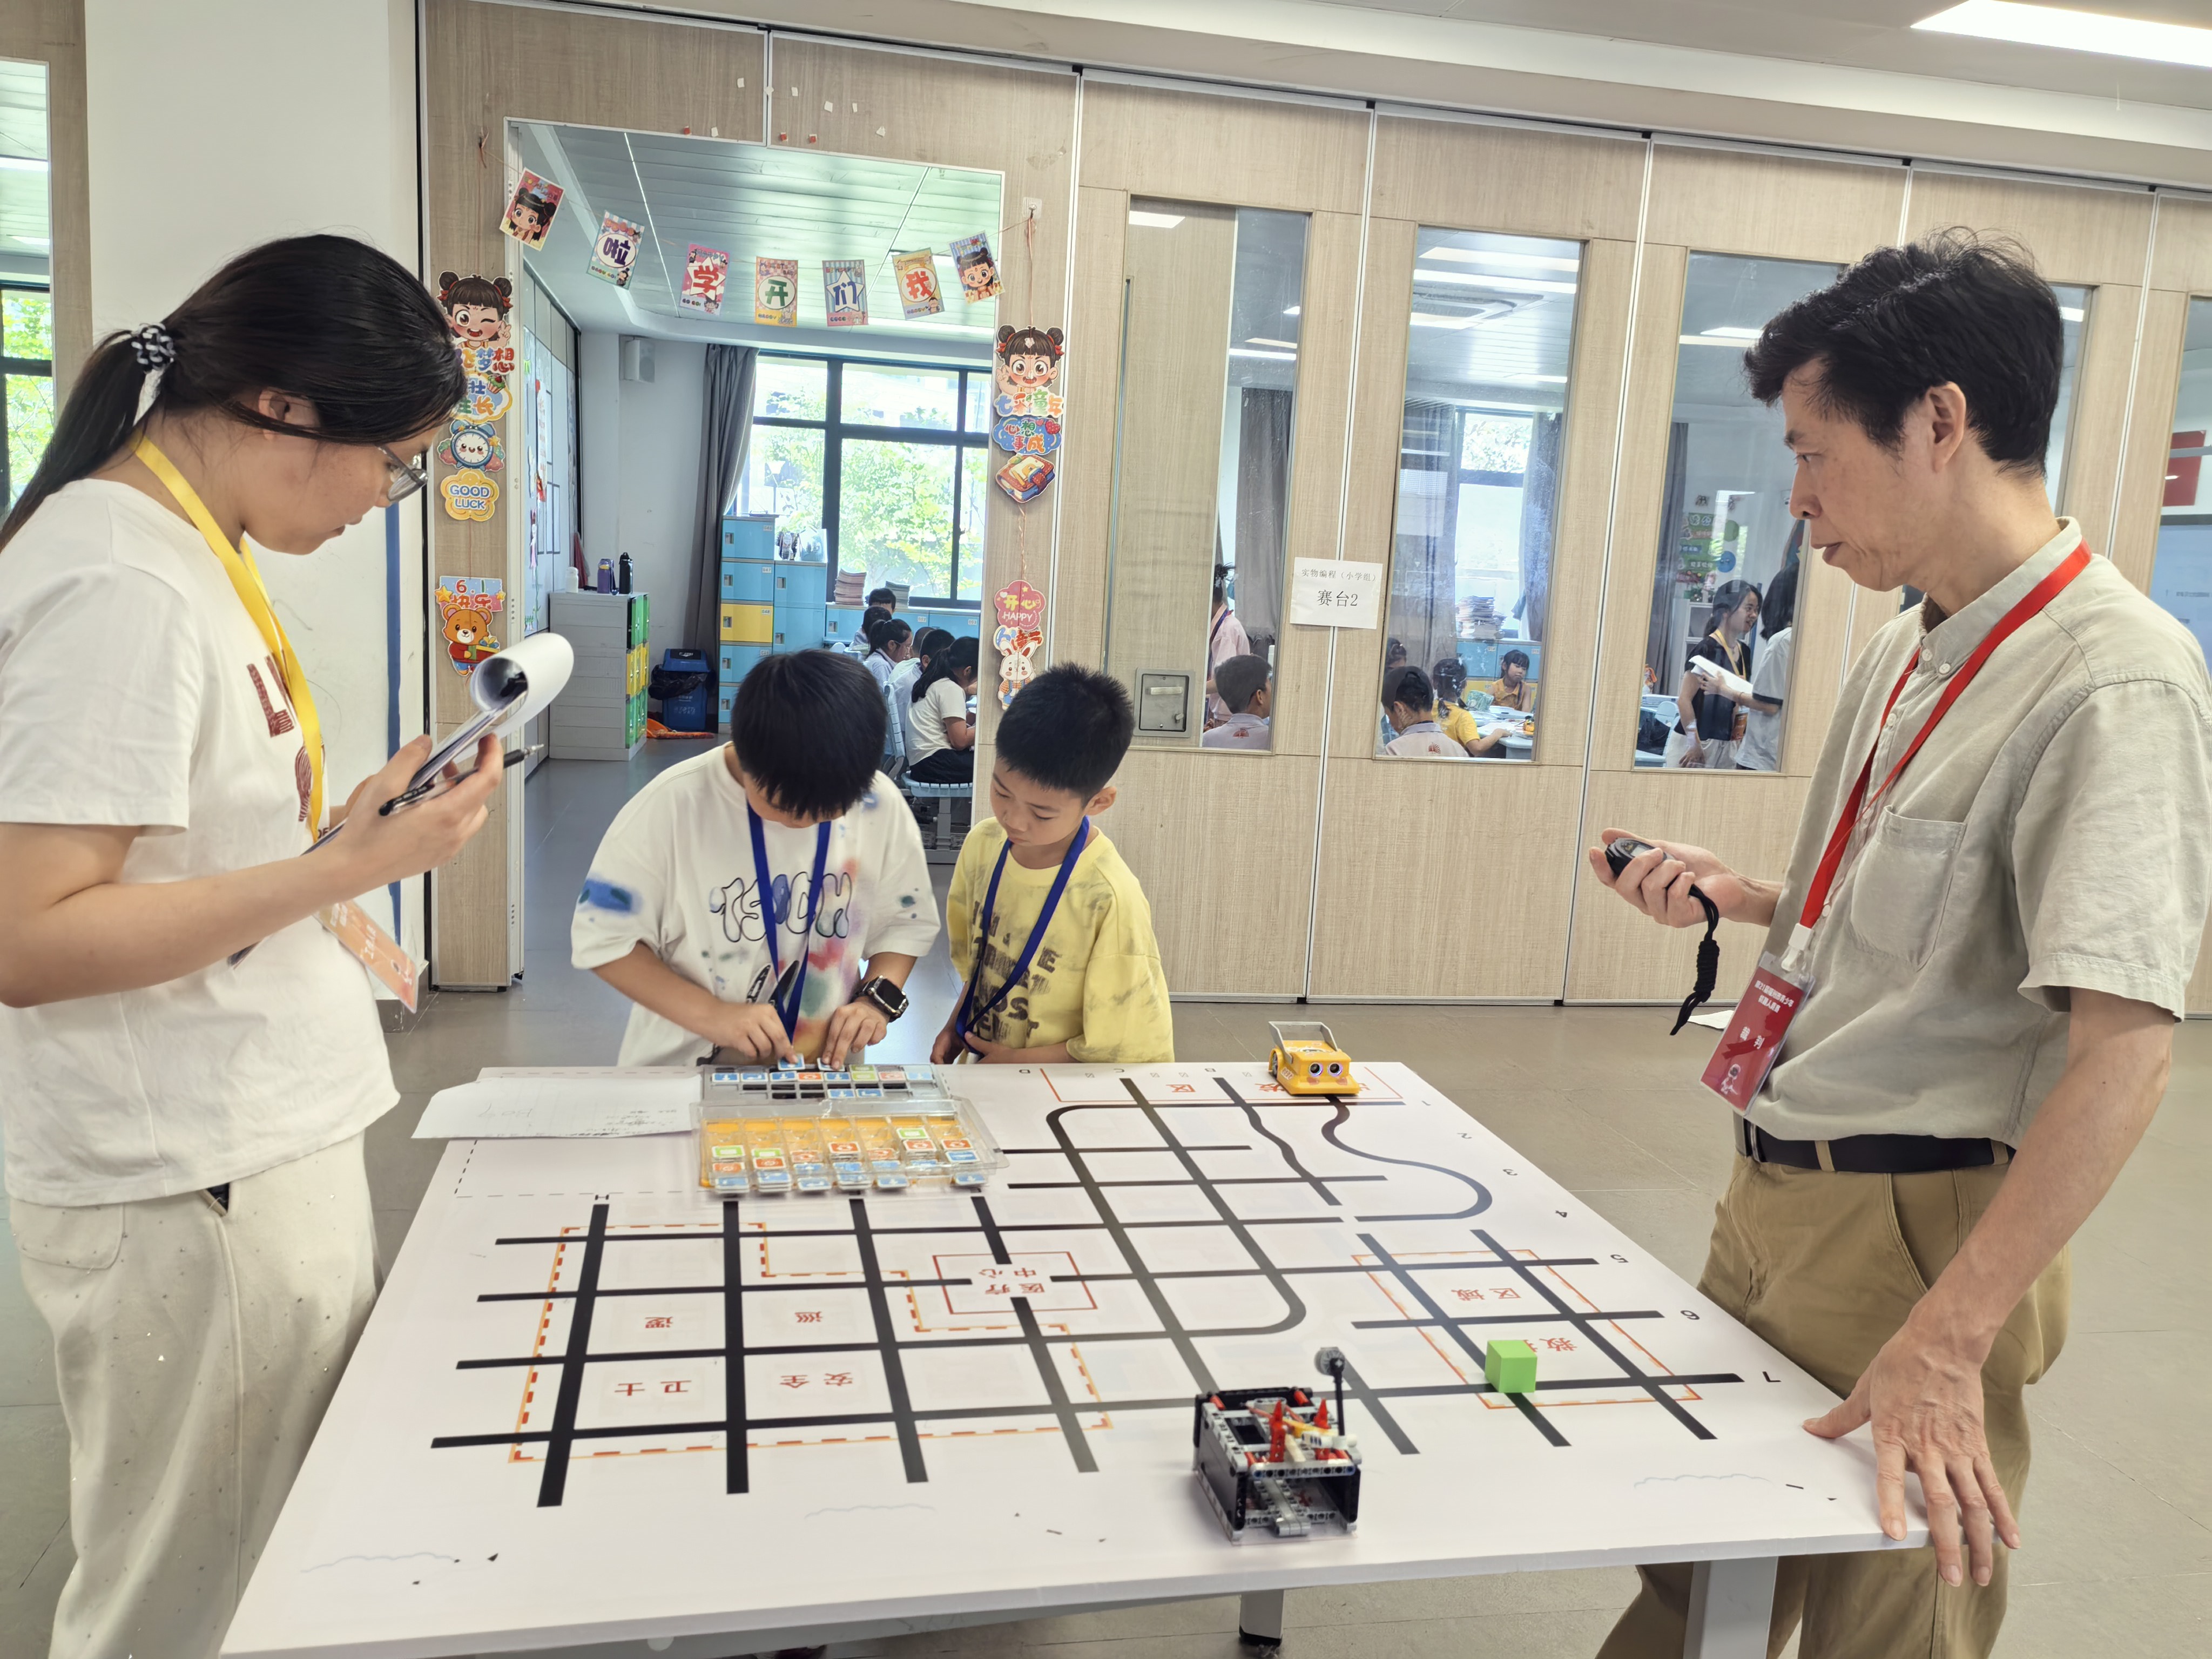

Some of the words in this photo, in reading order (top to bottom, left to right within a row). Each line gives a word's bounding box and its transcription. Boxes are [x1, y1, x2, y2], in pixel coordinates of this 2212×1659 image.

[603, 237, 631, 265] 啦
[693, 265, 719, 293] 学
[906, 271, 932, 299] 我
[765, 279, 788, 307] 开
[833, 281, 857, 305] 们
[995, 389, 1063, 416] 七彩童年
[1004, 420, 1036, 437] 心想
[1012, 434, 1046, 454] 事成
[450, 484, 490, 498] GOOD
[454, 498, 485, 510] LUCK
[456, 579, 485, 593] 6.1
[1003, 595, 1036, 611] 开心
[1317, 590, 1358, 607] 赛台2
[1002, 611, 1033, 622] HAPPY
[1502, 1168, 1518, 1176] 3
[1555, 1210, 1568, 1218] 4
[1610, 1253, 1629, 1263] 5
[1762, 1371, 1782, 1382] 7
